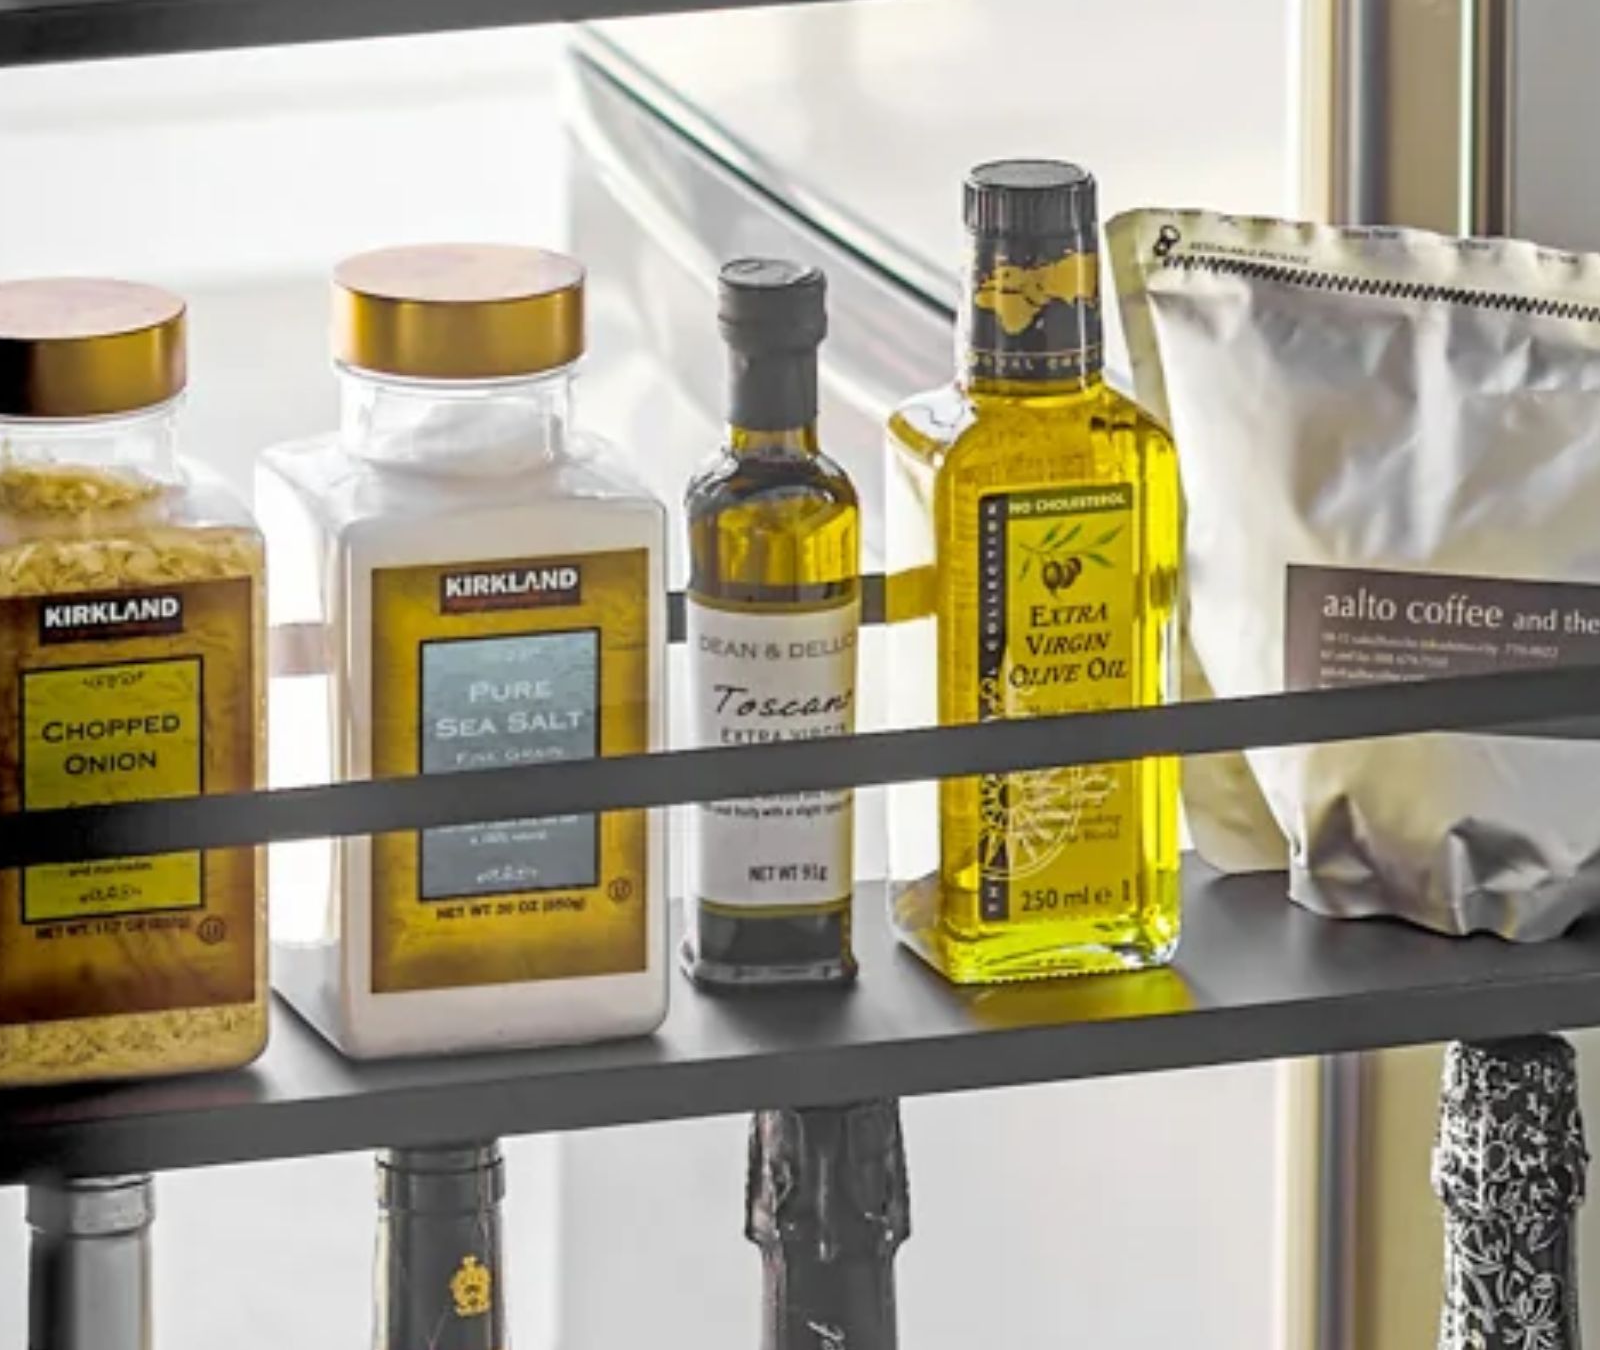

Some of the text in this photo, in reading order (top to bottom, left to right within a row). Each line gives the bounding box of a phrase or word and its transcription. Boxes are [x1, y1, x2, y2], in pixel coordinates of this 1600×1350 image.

[1009, 492, 1126, 515] NO CHOLESTEROL
[445, 566, 579, 598] KIRKLAND
[44, 596, 180, 629] KIRKLAND
[1030, 601, 1108, 628] EXTRA
[1322, 588, 1398, 622] aalto
[1405, 593, 1504, 629] coffee
[1511, 609, 1556, 634] and
[764, 642, 781, 660] &
[1025, 631, 1110, 656] VIRGIN
[1008, 655, 1129, 689] OLIVE OIL
[469, 679, 553, 703] PURE
[41, 713, 182, 744] CHOPPED
[435, 710, 585, 740] SEA SALT
[63, 750, 158, 776] ONION
[747, 864, 775, 881] NET
[778, 863, 798, 881] WT
[436, 906, 465, 921] NET
[518, 899, 539, 913] OZ
[1021, 887, 1058, 912] 250
[1063, 884, 1090, 908] ml
